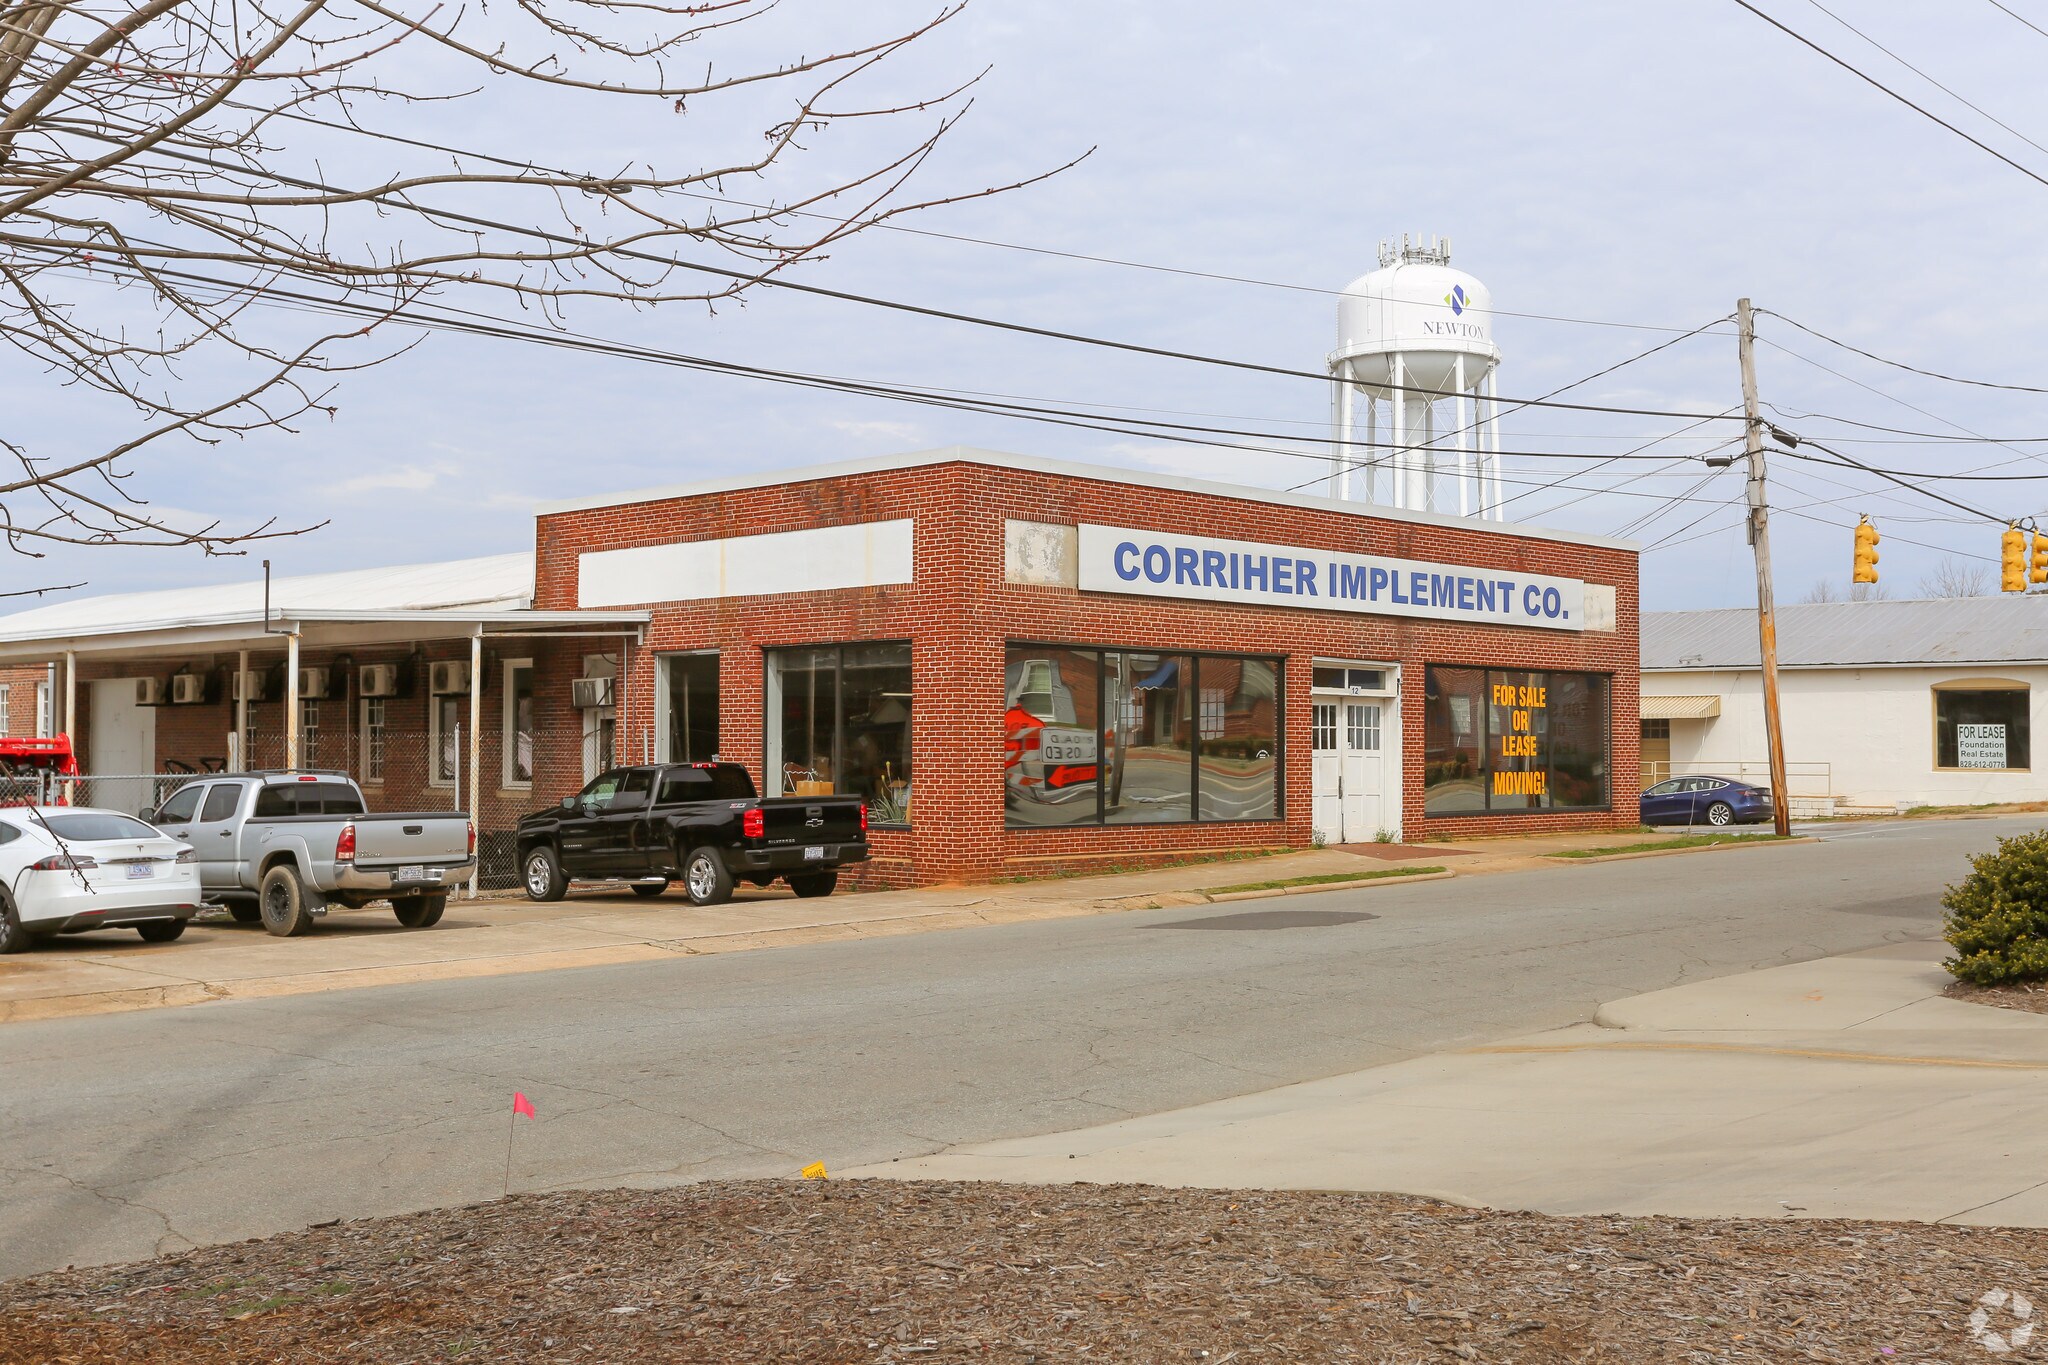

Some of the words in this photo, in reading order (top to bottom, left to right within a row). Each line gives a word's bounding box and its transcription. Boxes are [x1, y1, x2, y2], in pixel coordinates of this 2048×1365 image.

[1423, 321, 1484, 339] NEWTON
[1114, 542, 1317, 596] CORRIHER
[1329, 563, 1515, 613] IMPLEMENT
[1523, 585, 1569, 619] CO.
[1351, 687, 1359, 695] 12
[1493, 685, 1516, 706] FOR
[1519, 686, 1546, 708] SALE
[1512, 710, 1529, 731] OR
[1959, 726, 1976, 738] FOR
[1978, 726, 2004, 738] LEASE
[1502, 735, 1537, 757] LEASE
[1494, 771, 1546, 796] MOVING!
